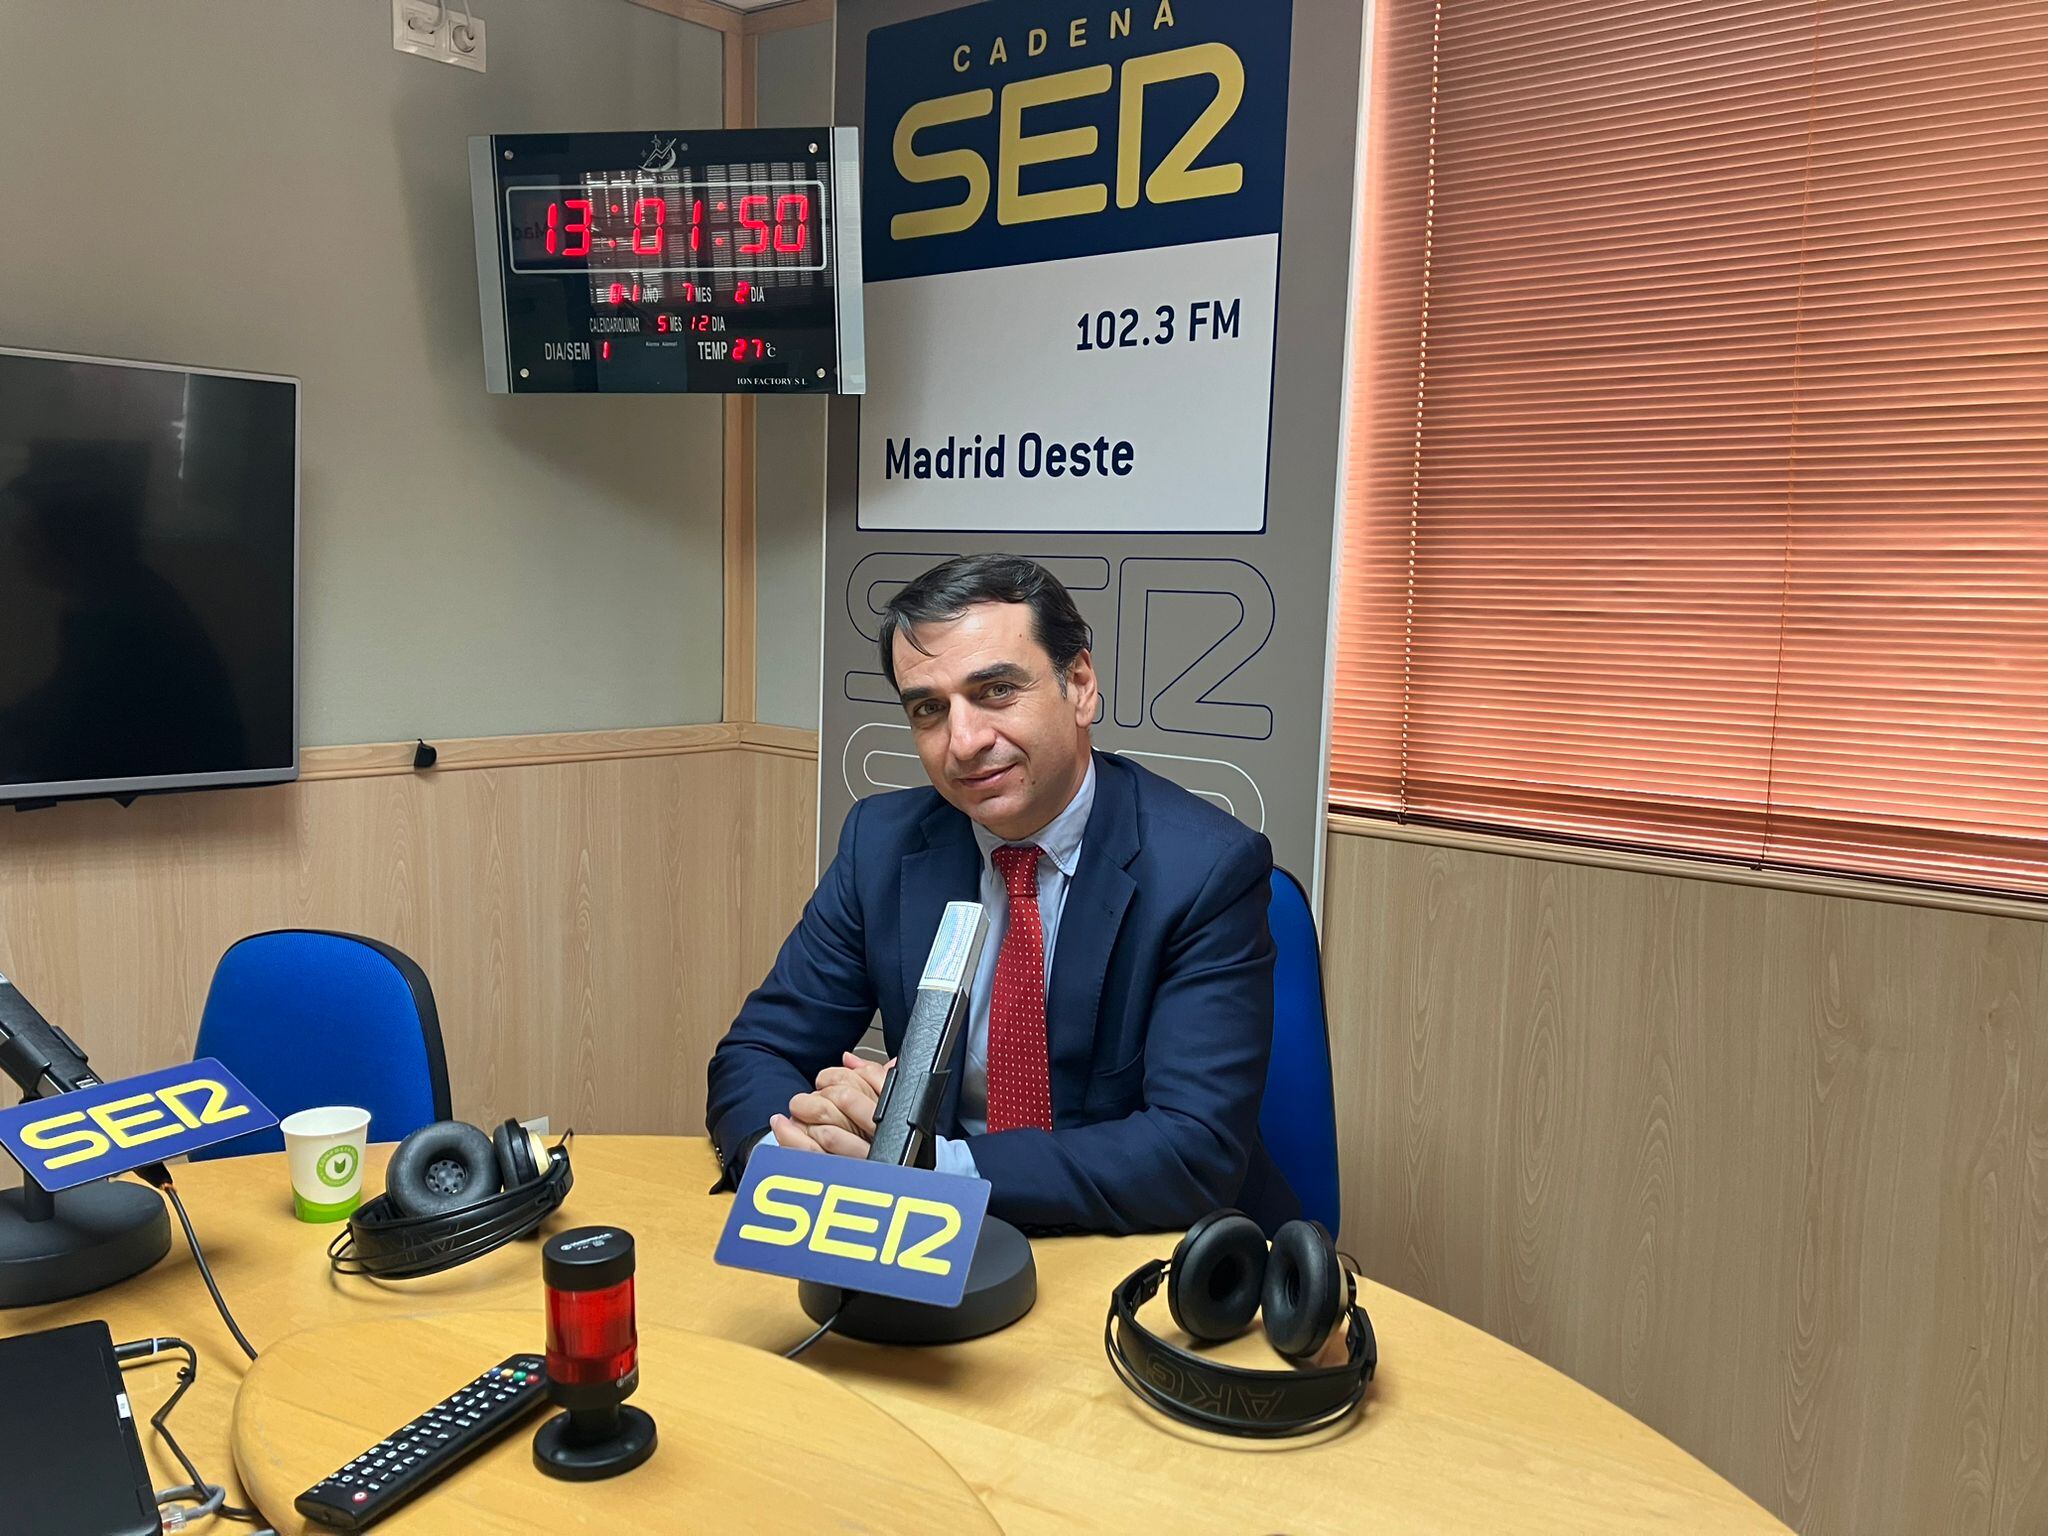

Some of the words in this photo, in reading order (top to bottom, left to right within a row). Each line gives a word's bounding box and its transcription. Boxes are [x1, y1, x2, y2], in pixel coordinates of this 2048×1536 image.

[953, 0, 1175, 73] CADENA
[890, 42, 1245, 240] SER
[546, 194, 808, 256] 13:01:50
[682, 282, 694, 302] 7
[695, 286, 712, 303] MES
[734, 281, 750, 304] 2
[751, 286, 765, 303] DIA
[657, 315, 668, 332] 5
[669, 316, 683, 332] MES
[712, 316, 726, 332] DIA
[697, 341, 728, 361] TEMP
[731, 338, 764, 360] 27
[1076, 304, 1175, 351] 102.3
[1188, 298, 1241, 342] FM
[885, 434, 1006, 480] Madrid
[1018, 432, 1134, 478] Oeste
[20, 1078, 250, 1170] SER
[739, 1174, 962, 1276] SER
